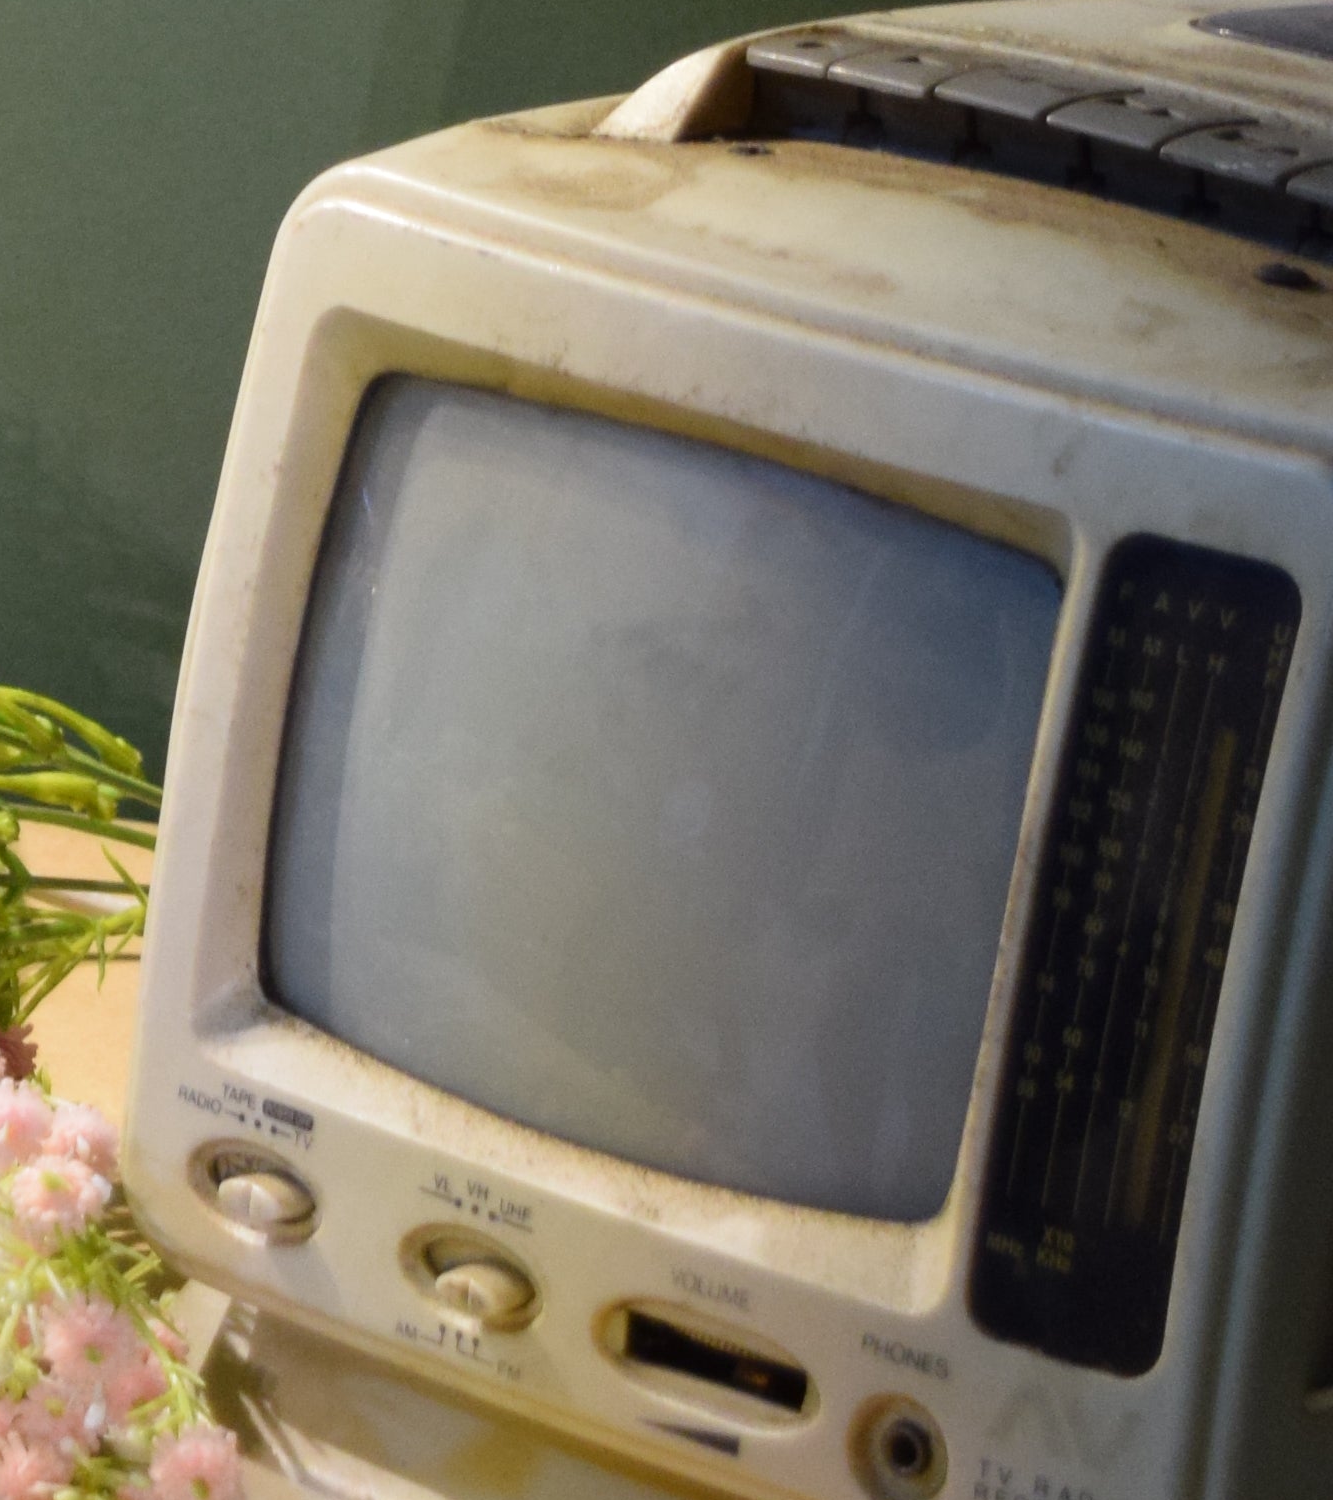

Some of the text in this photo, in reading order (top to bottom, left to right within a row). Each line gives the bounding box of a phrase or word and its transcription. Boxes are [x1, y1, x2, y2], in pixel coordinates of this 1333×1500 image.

[178, 1083, 222, 1115] RADIO
[222, 1082, 257, 1111] TAPE
[295, 1131, 315, 1152] TV
[671, 1267, 751, 1309] VOLUME
[860, 1332, 950, 1379] PHONES
[979, 1457, 1013, 1485] TV
